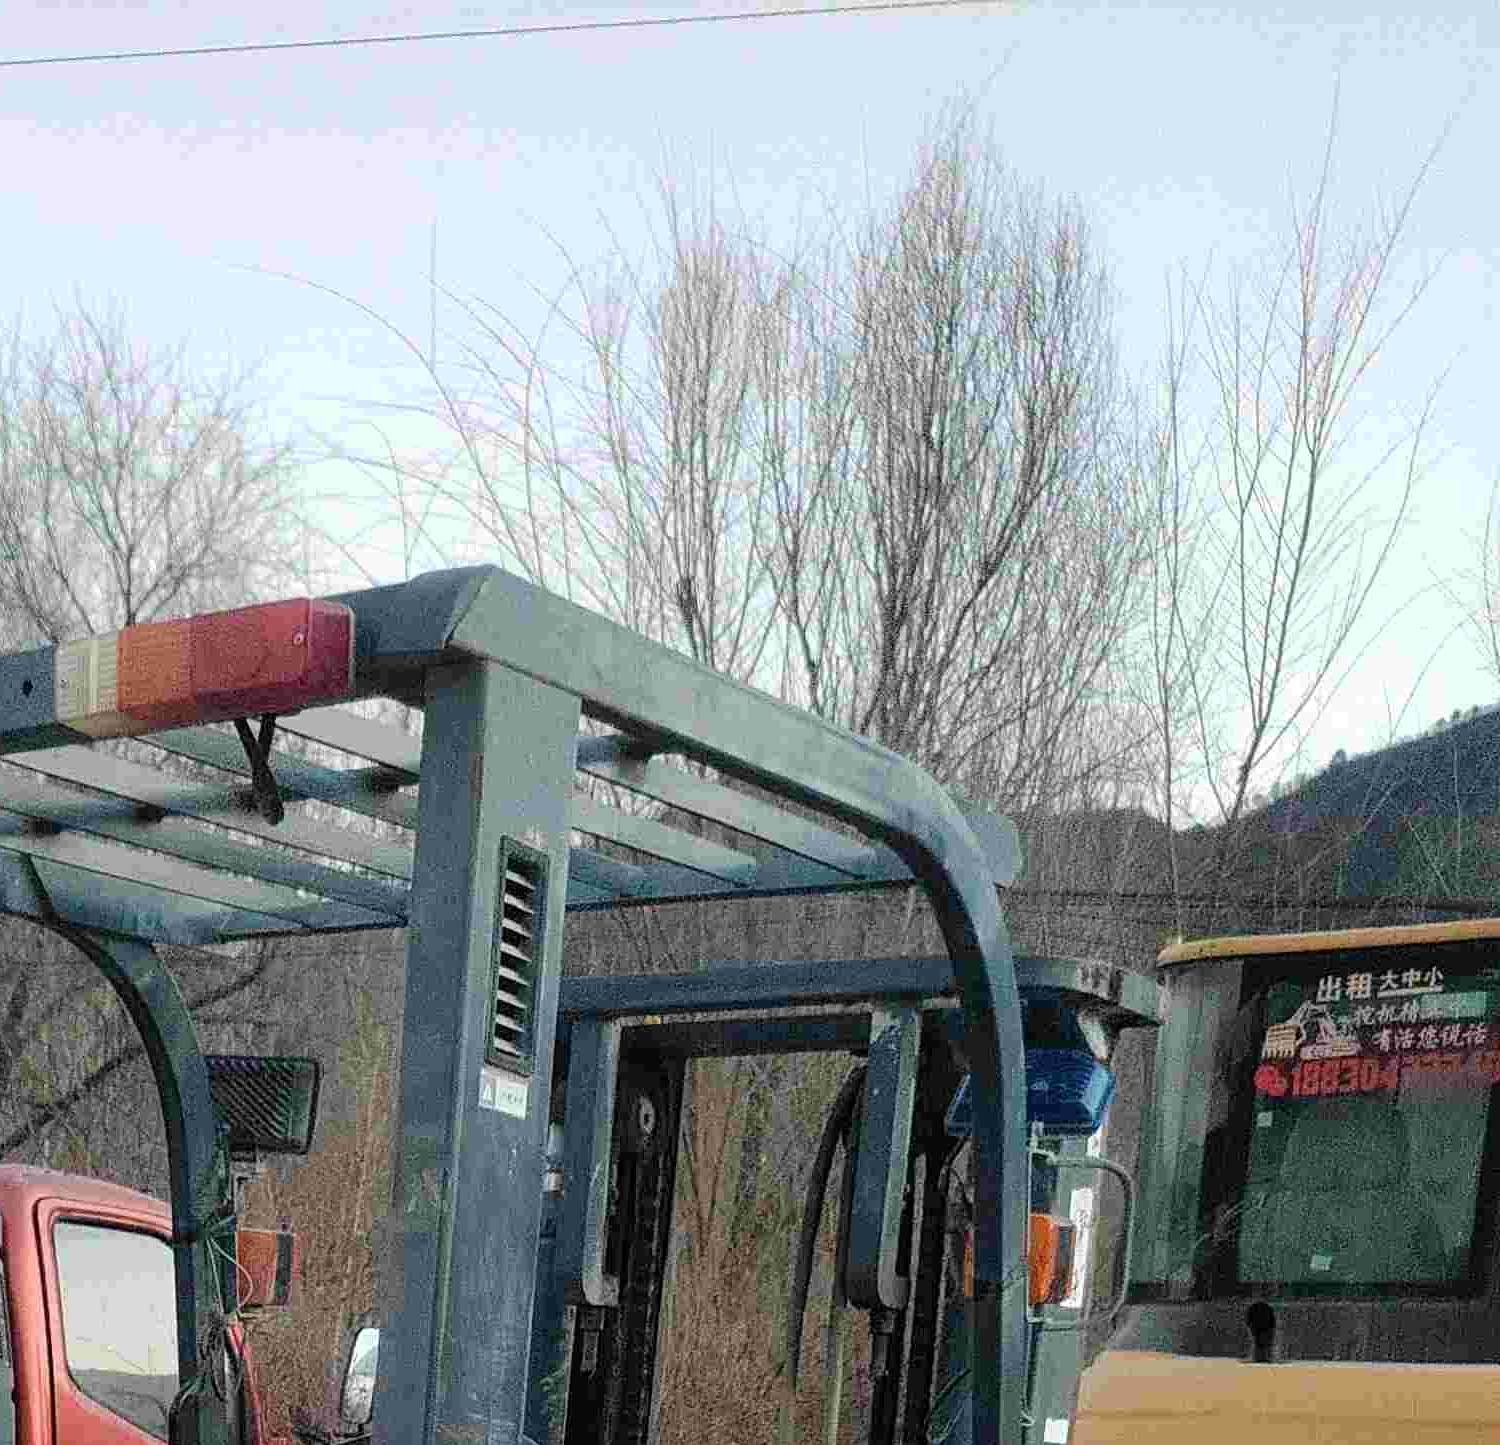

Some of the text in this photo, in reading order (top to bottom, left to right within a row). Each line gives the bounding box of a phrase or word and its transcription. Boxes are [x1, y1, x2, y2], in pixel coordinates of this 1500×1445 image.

[1315, 965, 1445, 1001] 出租 大中小
